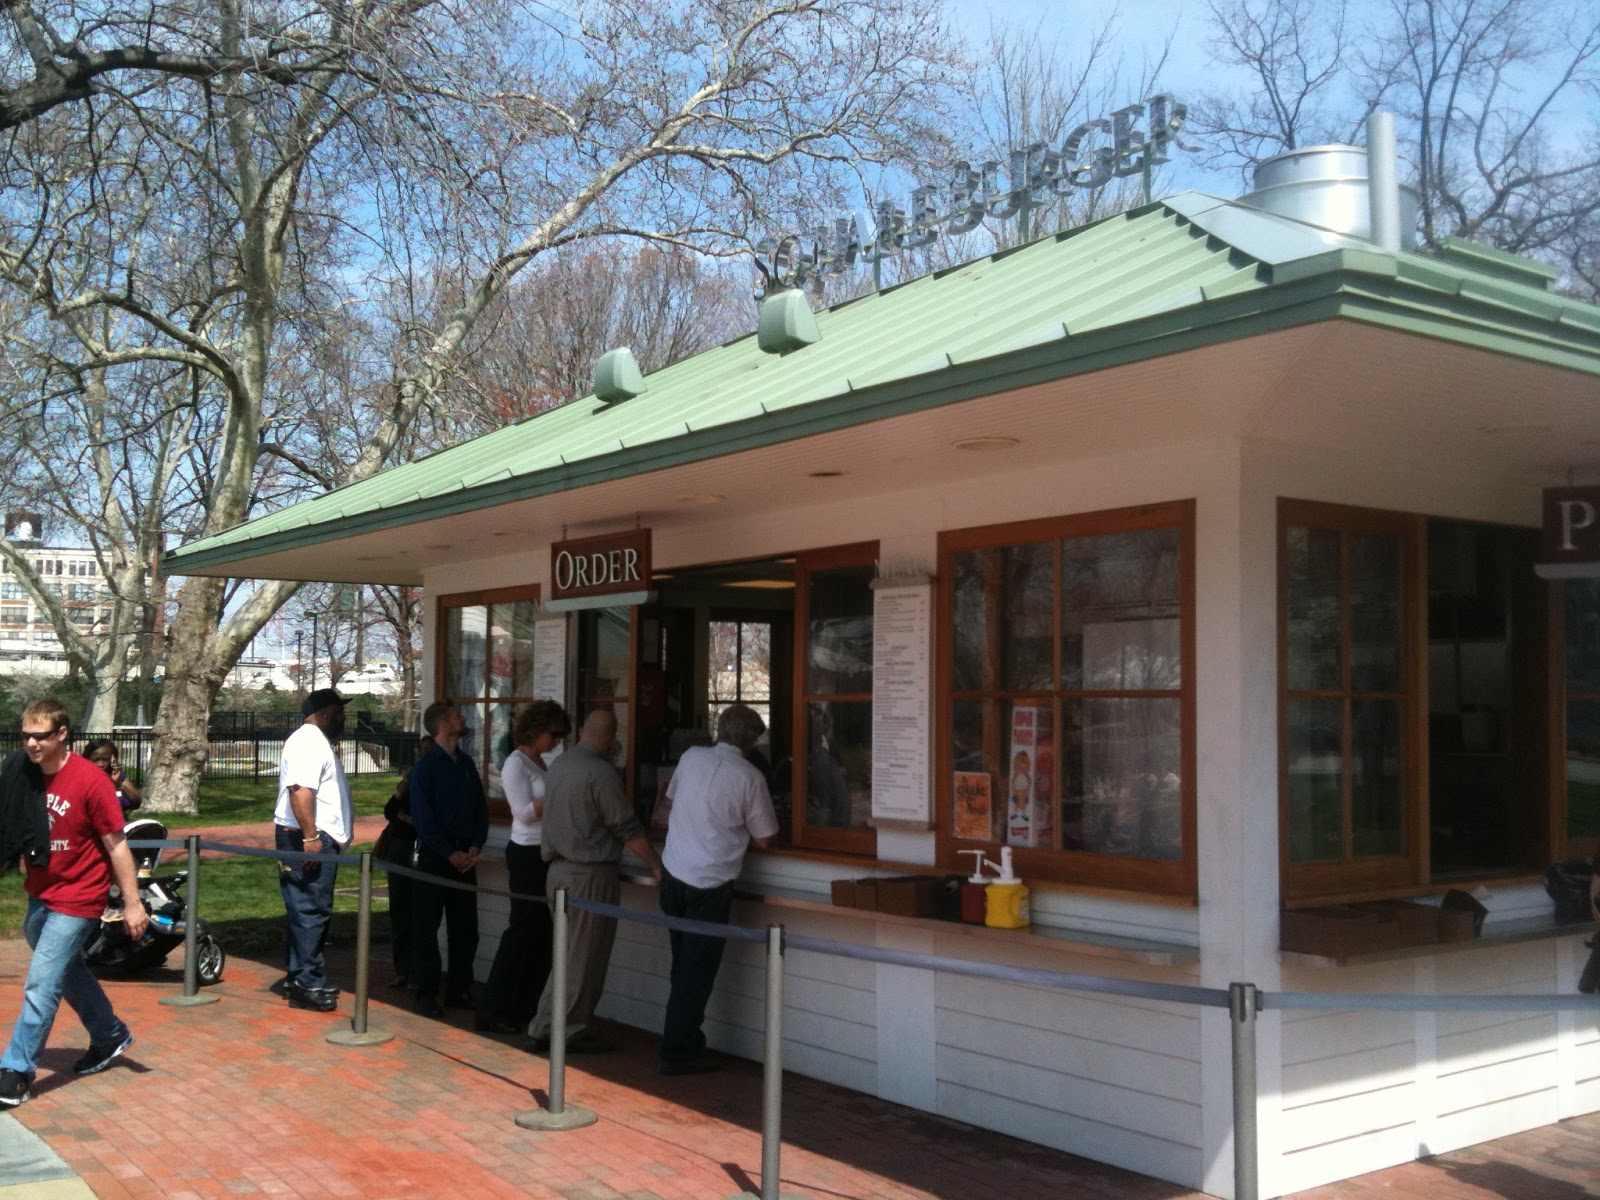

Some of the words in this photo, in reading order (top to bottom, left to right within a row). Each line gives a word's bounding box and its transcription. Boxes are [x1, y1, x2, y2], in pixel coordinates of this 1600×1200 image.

[1556, 499, 1597, 550] P
[555, 548, 640, 590] ORDER
[46, 793, 71, 817] PLE
